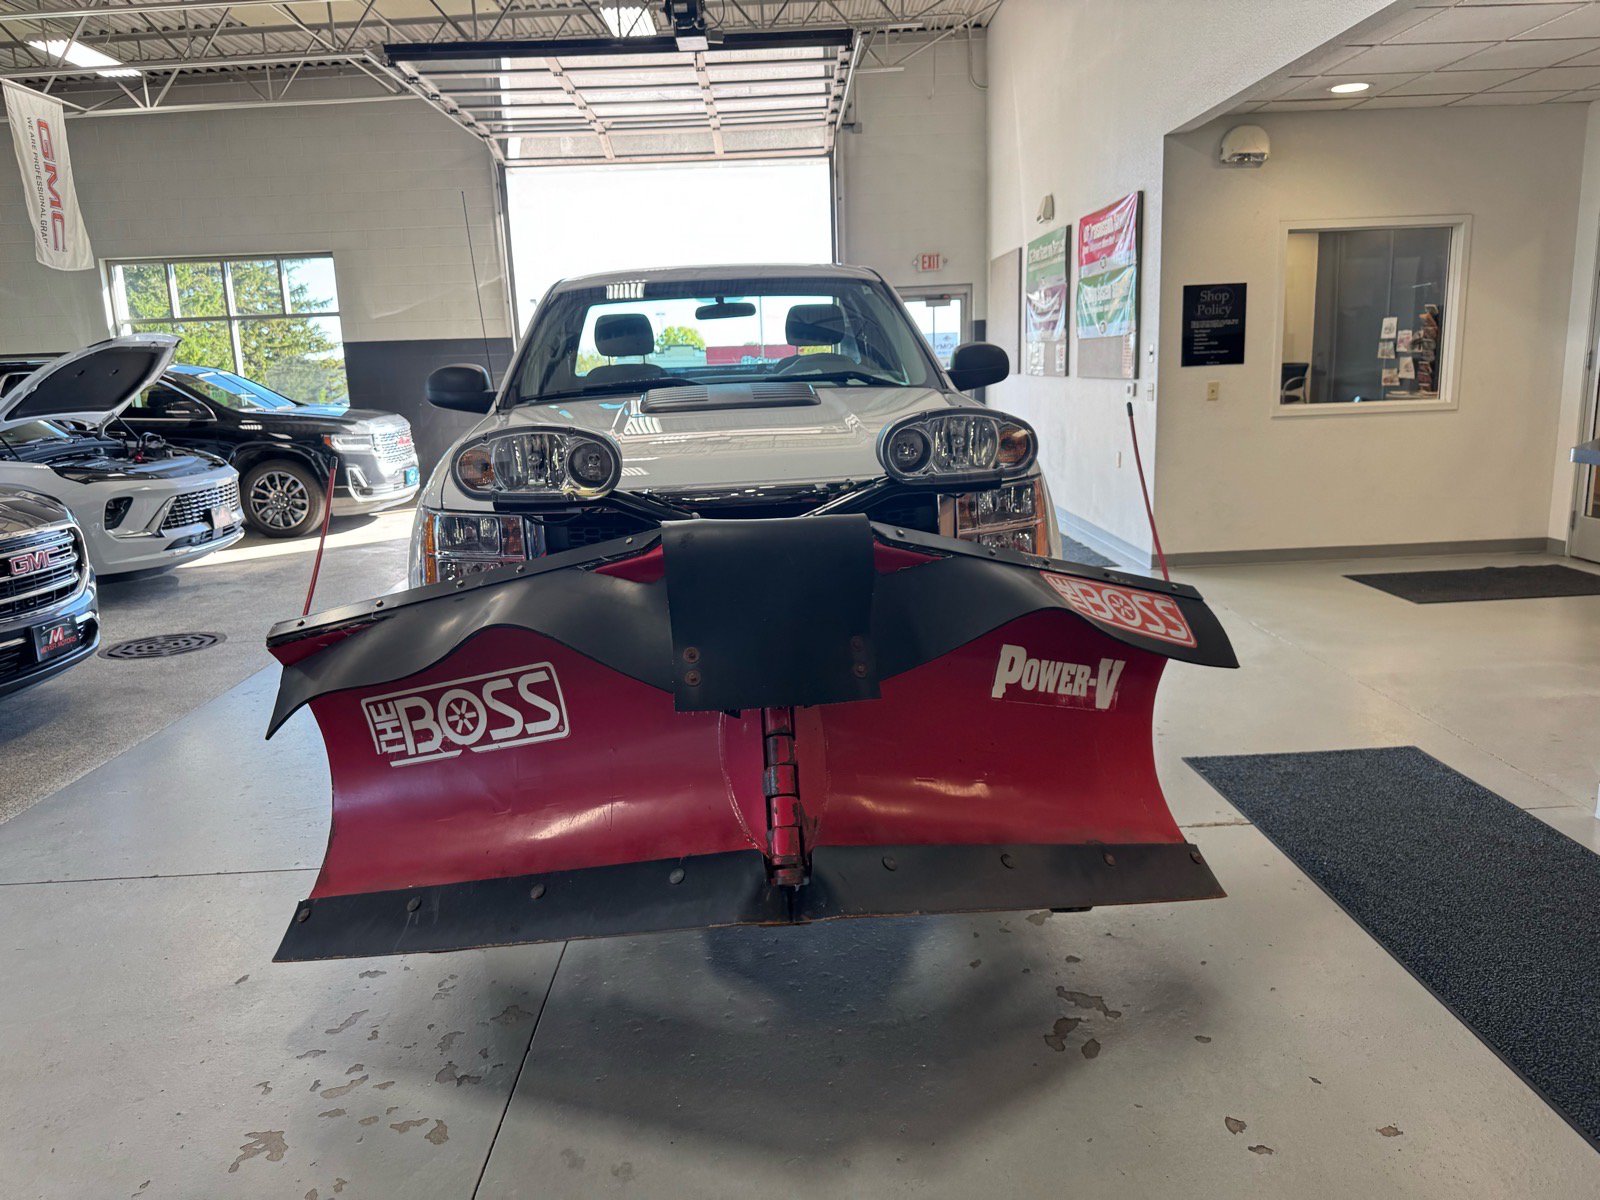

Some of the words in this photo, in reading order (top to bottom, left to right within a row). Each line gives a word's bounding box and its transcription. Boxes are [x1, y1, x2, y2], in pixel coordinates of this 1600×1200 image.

[27, 116, 34, 130] WE
[33, 152, 47, 218] PROFESSIONAL
[37, 118, 67, 252] GMC
[921, 254, 940, 270] EXIT
[1197, 304, 1232, 318] Policy
[1200, 290, 1230, 304] Shop
[9, 547, 60, 575] GMC
[1050, 577, 1088, 610] THE
[1071, 582, 1188, 639] BOSS
[369, 702, 407, 753] THE
[394, 670, 560, 755] BOSS
